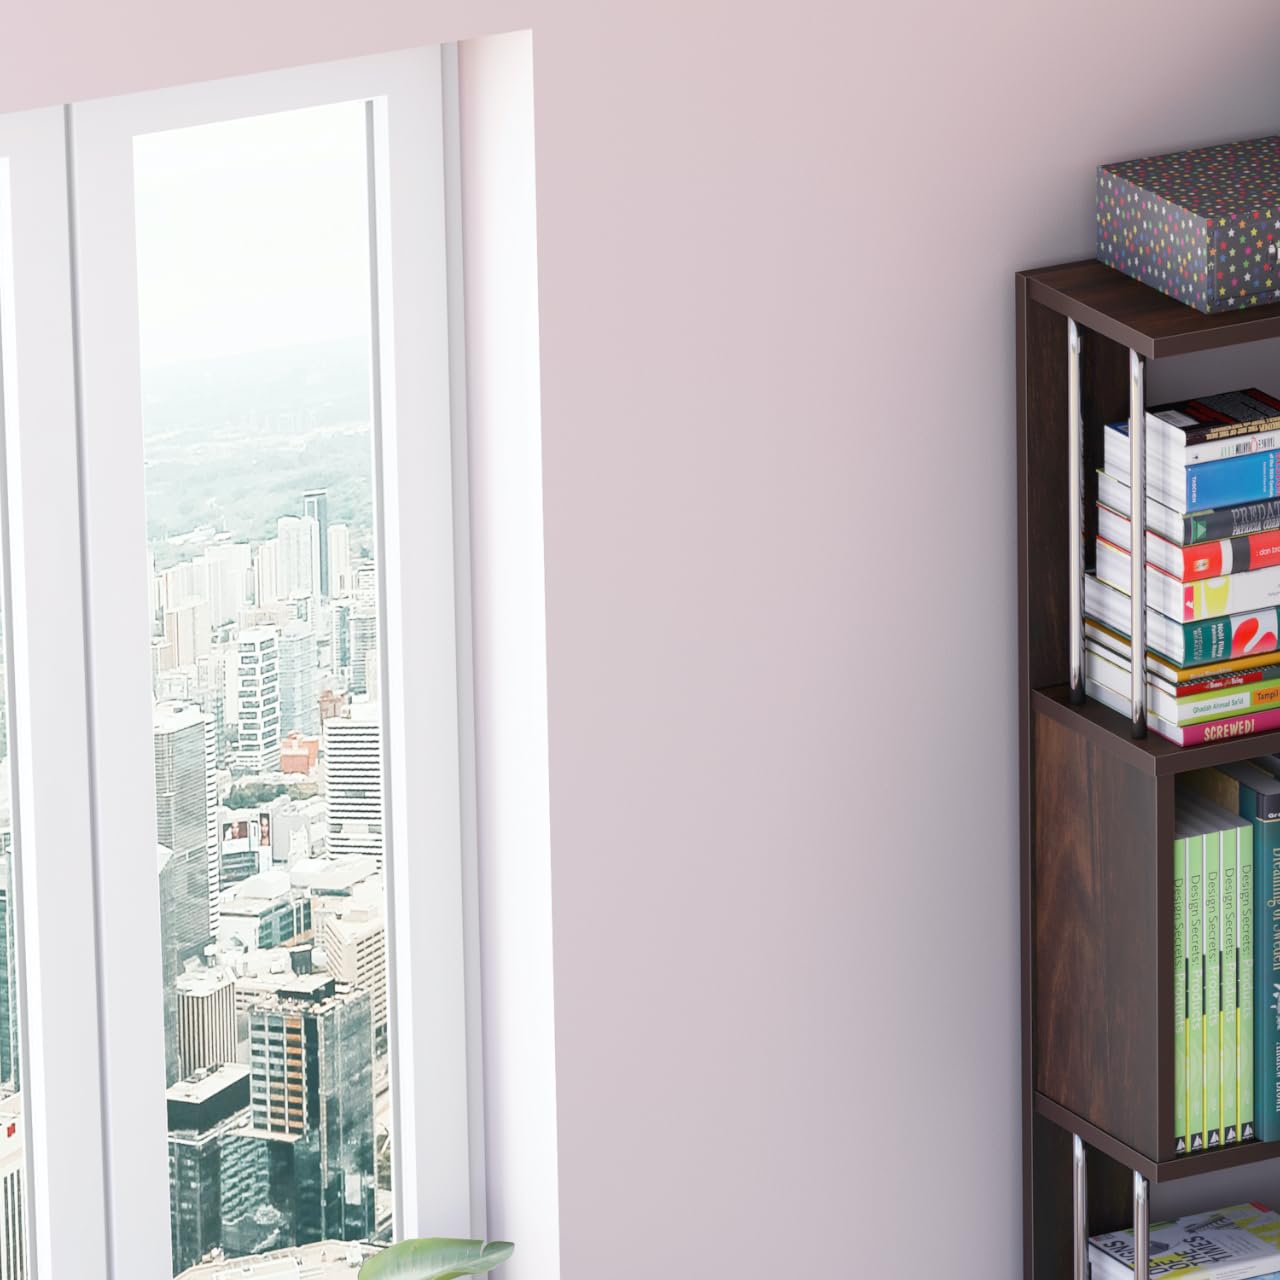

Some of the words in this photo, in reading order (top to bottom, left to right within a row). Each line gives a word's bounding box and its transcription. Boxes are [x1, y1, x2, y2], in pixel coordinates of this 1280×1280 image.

[1256, 690, 1278, 702] Tampil
[1189, 875, 1201, 913] Design
[1206, 872, 1218, 910] Design
[1223, 868, 1235, 906] Design
[1240, 865, 1251, 905] Design
[1191, 920, 1200, 966] Secrets:
[1209, 916, 1218, 962] Secrets:
[1225, 913, 1235, 959] Secrets:
[1242, 909, 1252, 956] Secrets:
